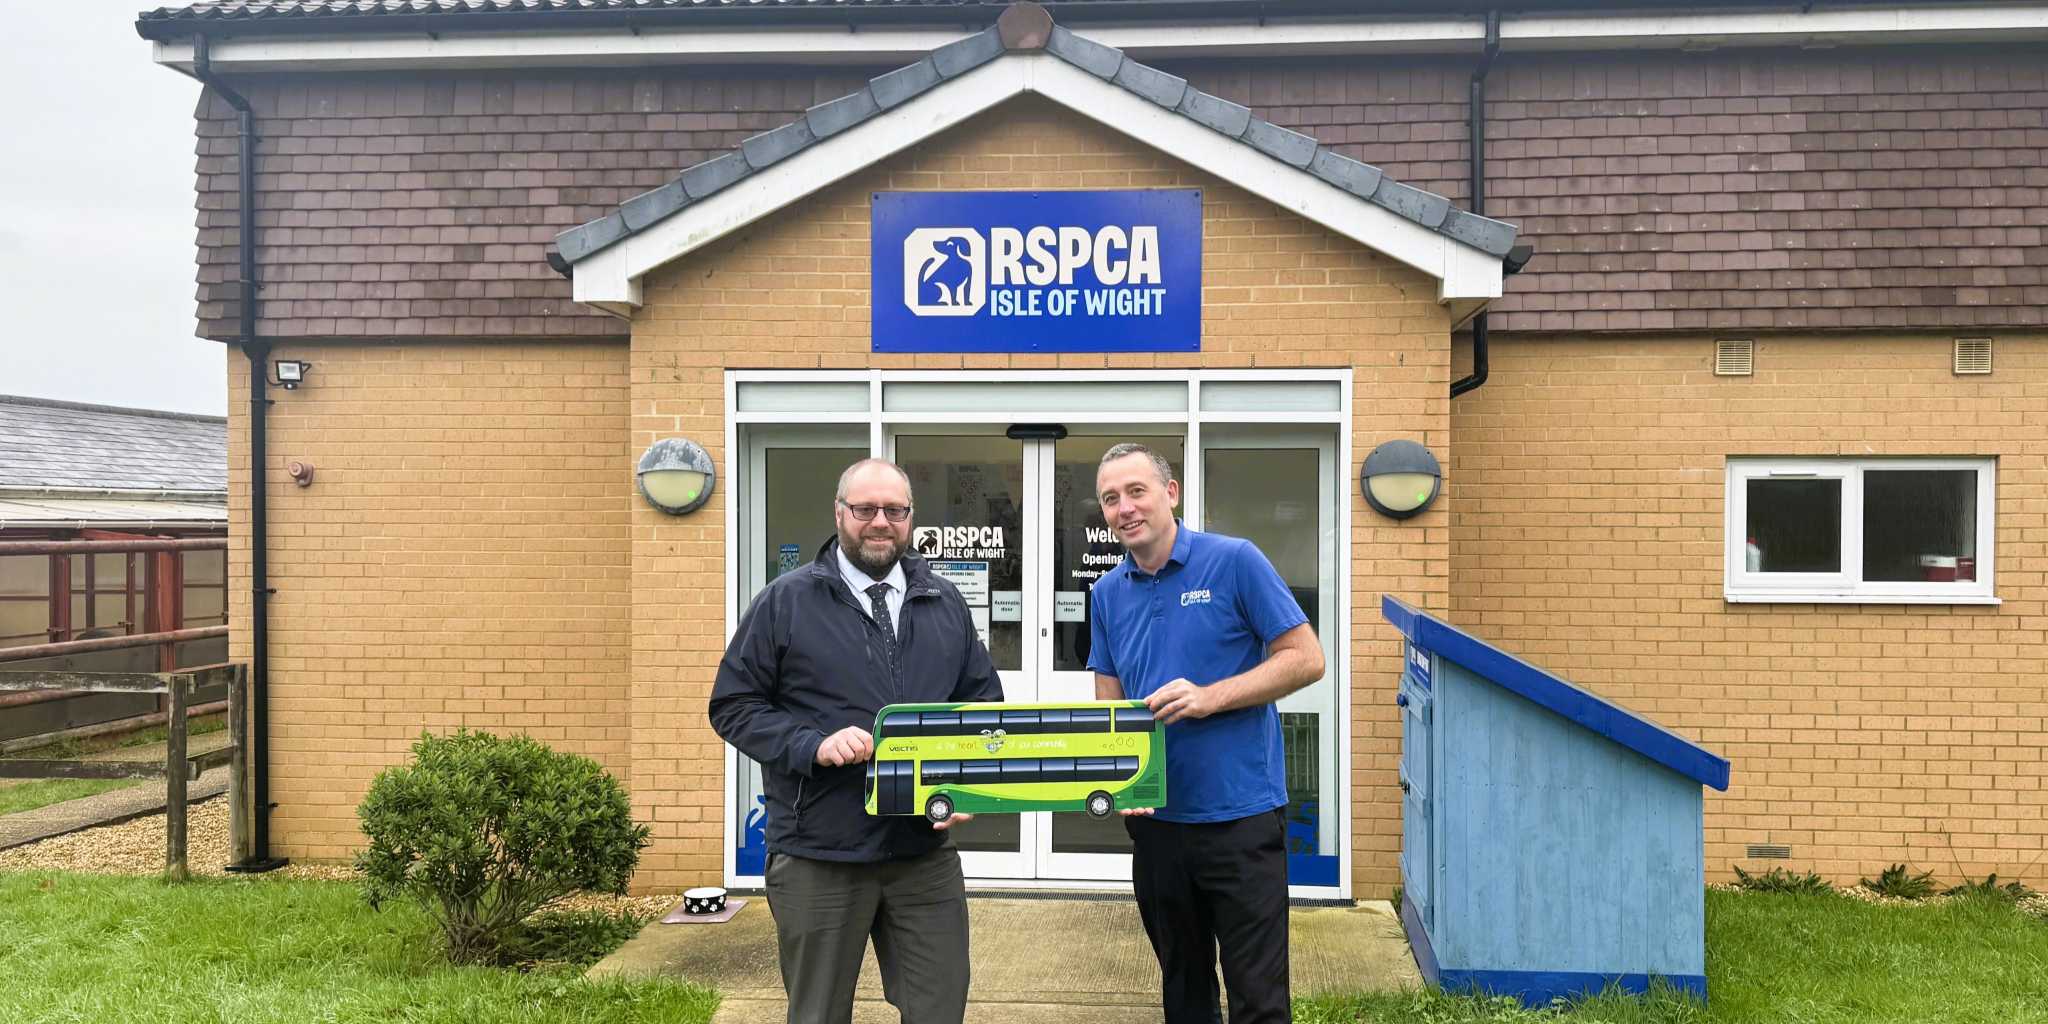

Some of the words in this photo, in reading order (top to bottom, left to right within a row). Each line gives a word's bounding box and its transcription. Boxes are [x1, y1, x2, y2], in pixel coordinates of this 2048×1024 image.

[990, 225, 1162, 286] RSPCA
[990, 289, 1042, 316] ISLE
[1047, 289, 1080, 316] OF
[1084, 288, 1166, 316] WIGHT
[943, 526, 1004, 548] RSPCA
[1085, 527, 1120, 543] Welc
[943, 548, 962, 558] ISLE
[963, 548, 973, 558] OF
[976, 548, 1005, 558] WIGHT
[1082, 553, 1124, 566] Opening
